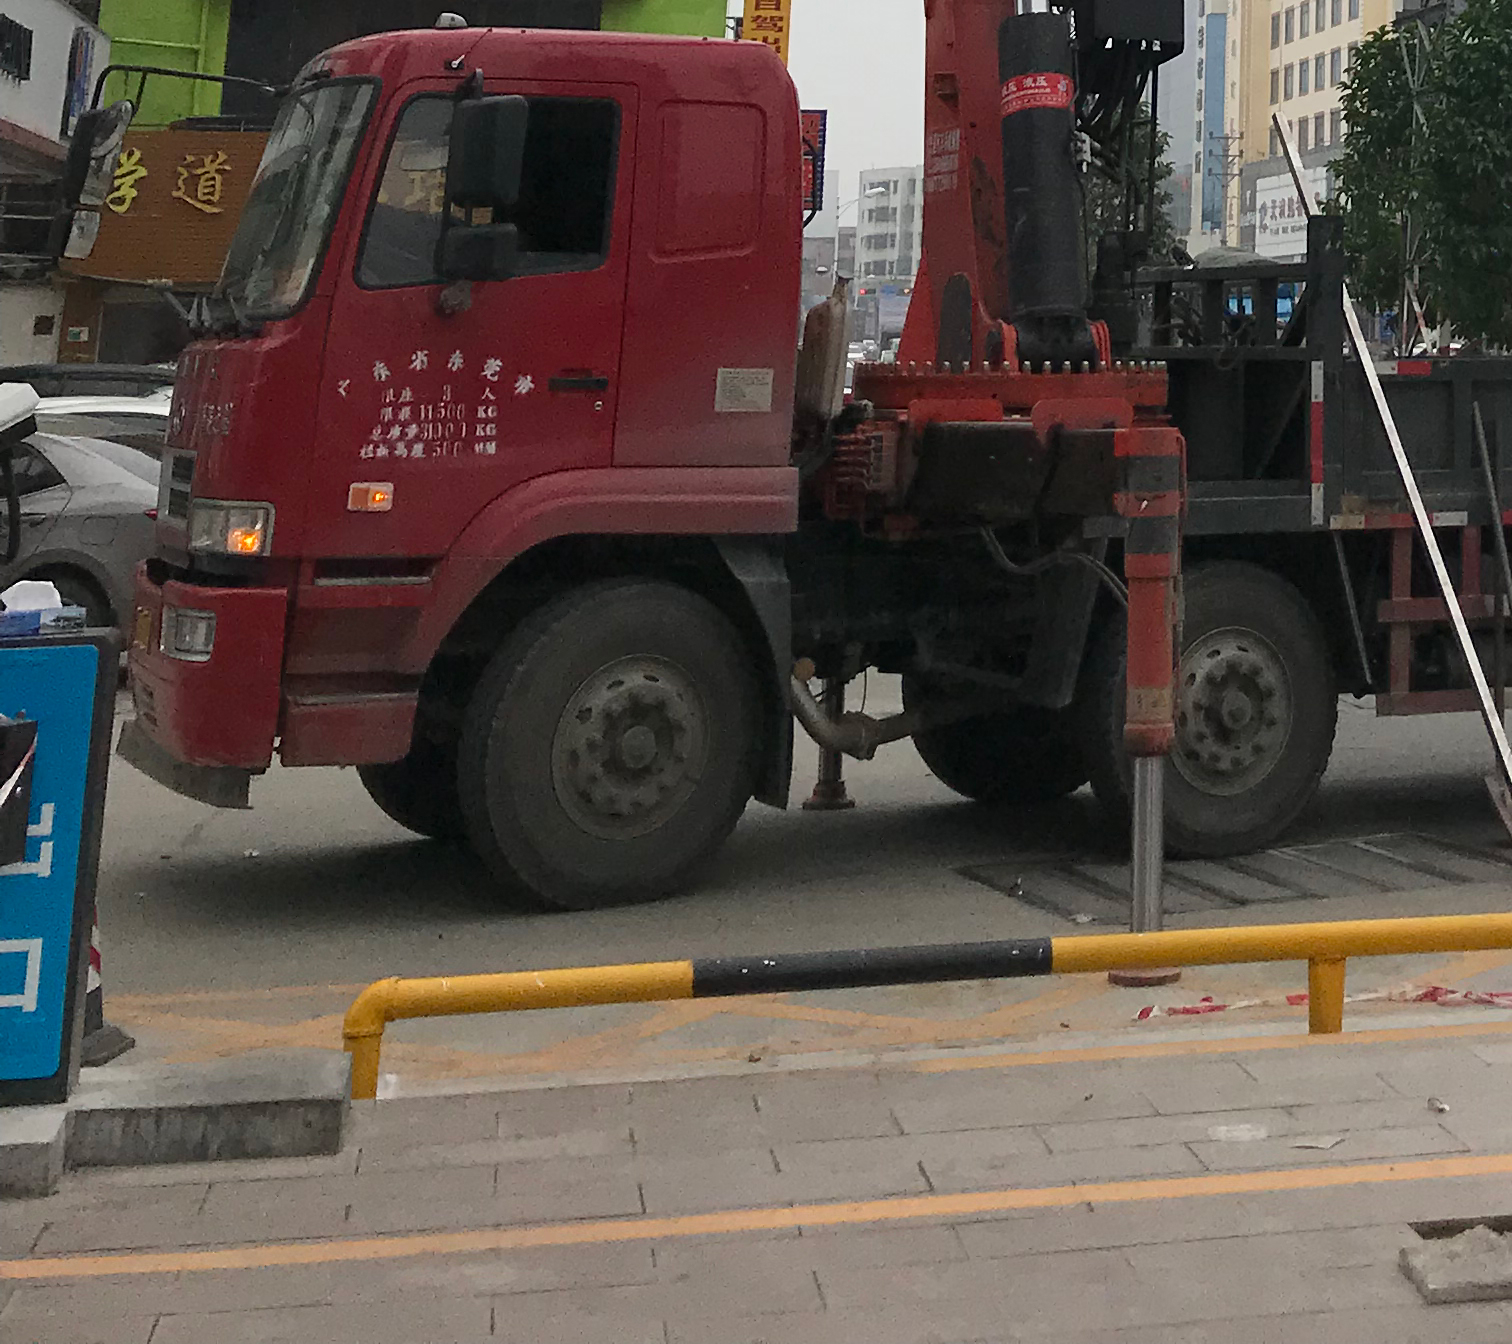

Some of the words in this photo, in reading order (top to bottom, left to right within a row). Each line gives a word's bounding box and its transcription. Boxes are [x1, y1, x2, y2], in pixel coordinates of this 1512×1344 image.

[481, 387, 496, 400] 人
[477, 405, 498, 419] KG
[475, 423, 497, 437] KG
